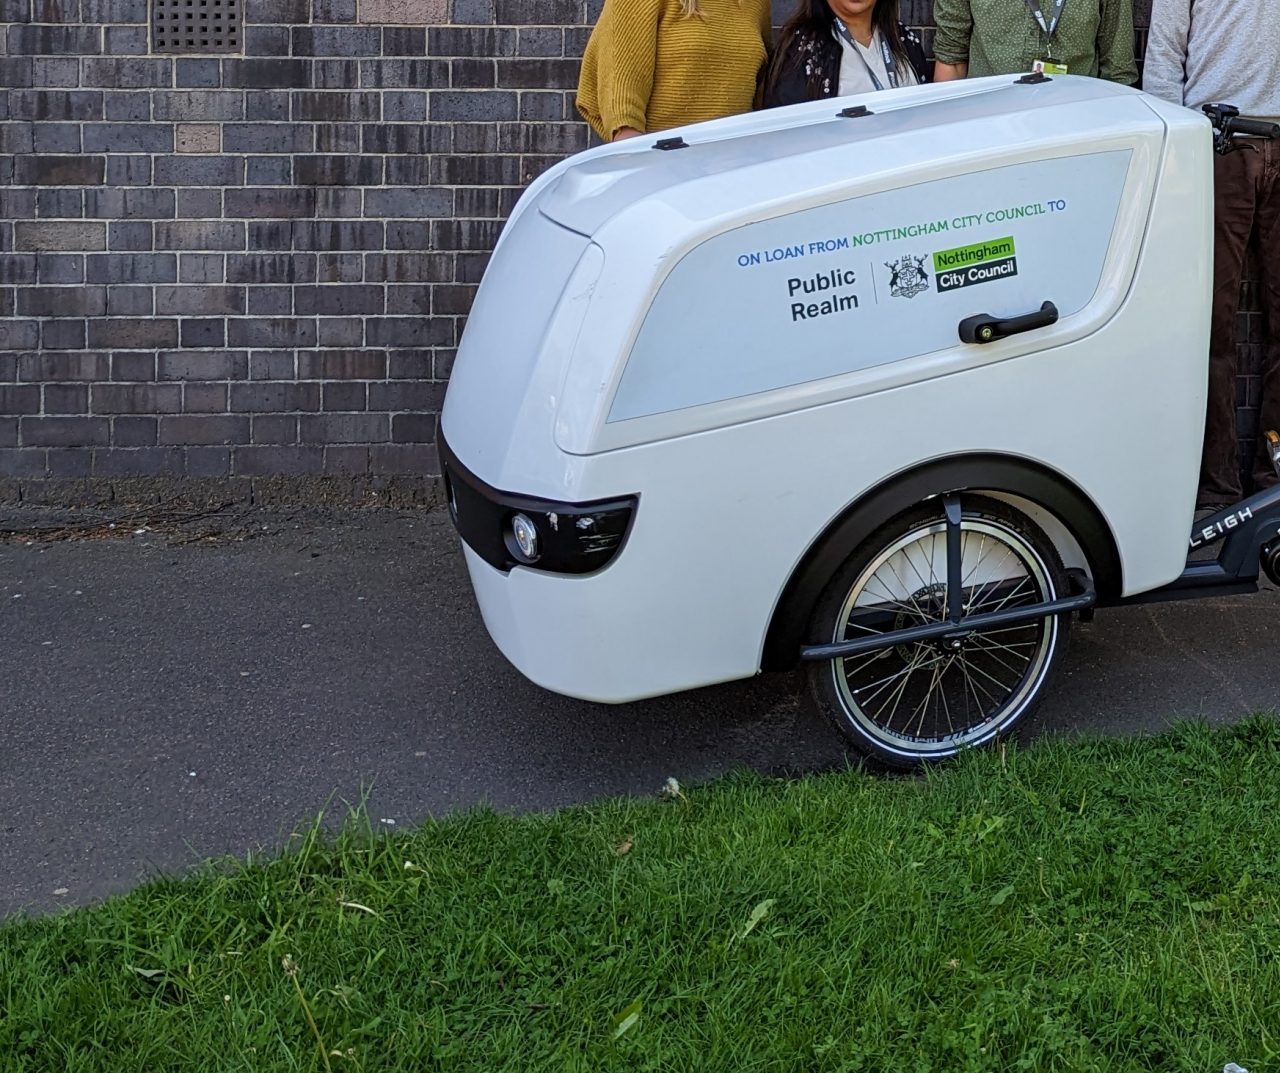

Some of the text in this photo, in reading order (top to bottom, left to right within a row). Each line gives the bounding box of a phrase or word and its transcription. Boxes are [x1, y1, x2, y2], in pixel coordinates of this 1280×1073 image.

[738, 199, 1066, 267] ON LOAN FROM NOTTINGHAM CITY COUNCIL TO
[937, 241, 1011, 268] Nottingham
[788, 267, 856, 297] Public
[939, 259, 1014, 290] City Council
[791, 291, 859, 322] Realm
[1189, 507, 1253, 547] LEIGH
